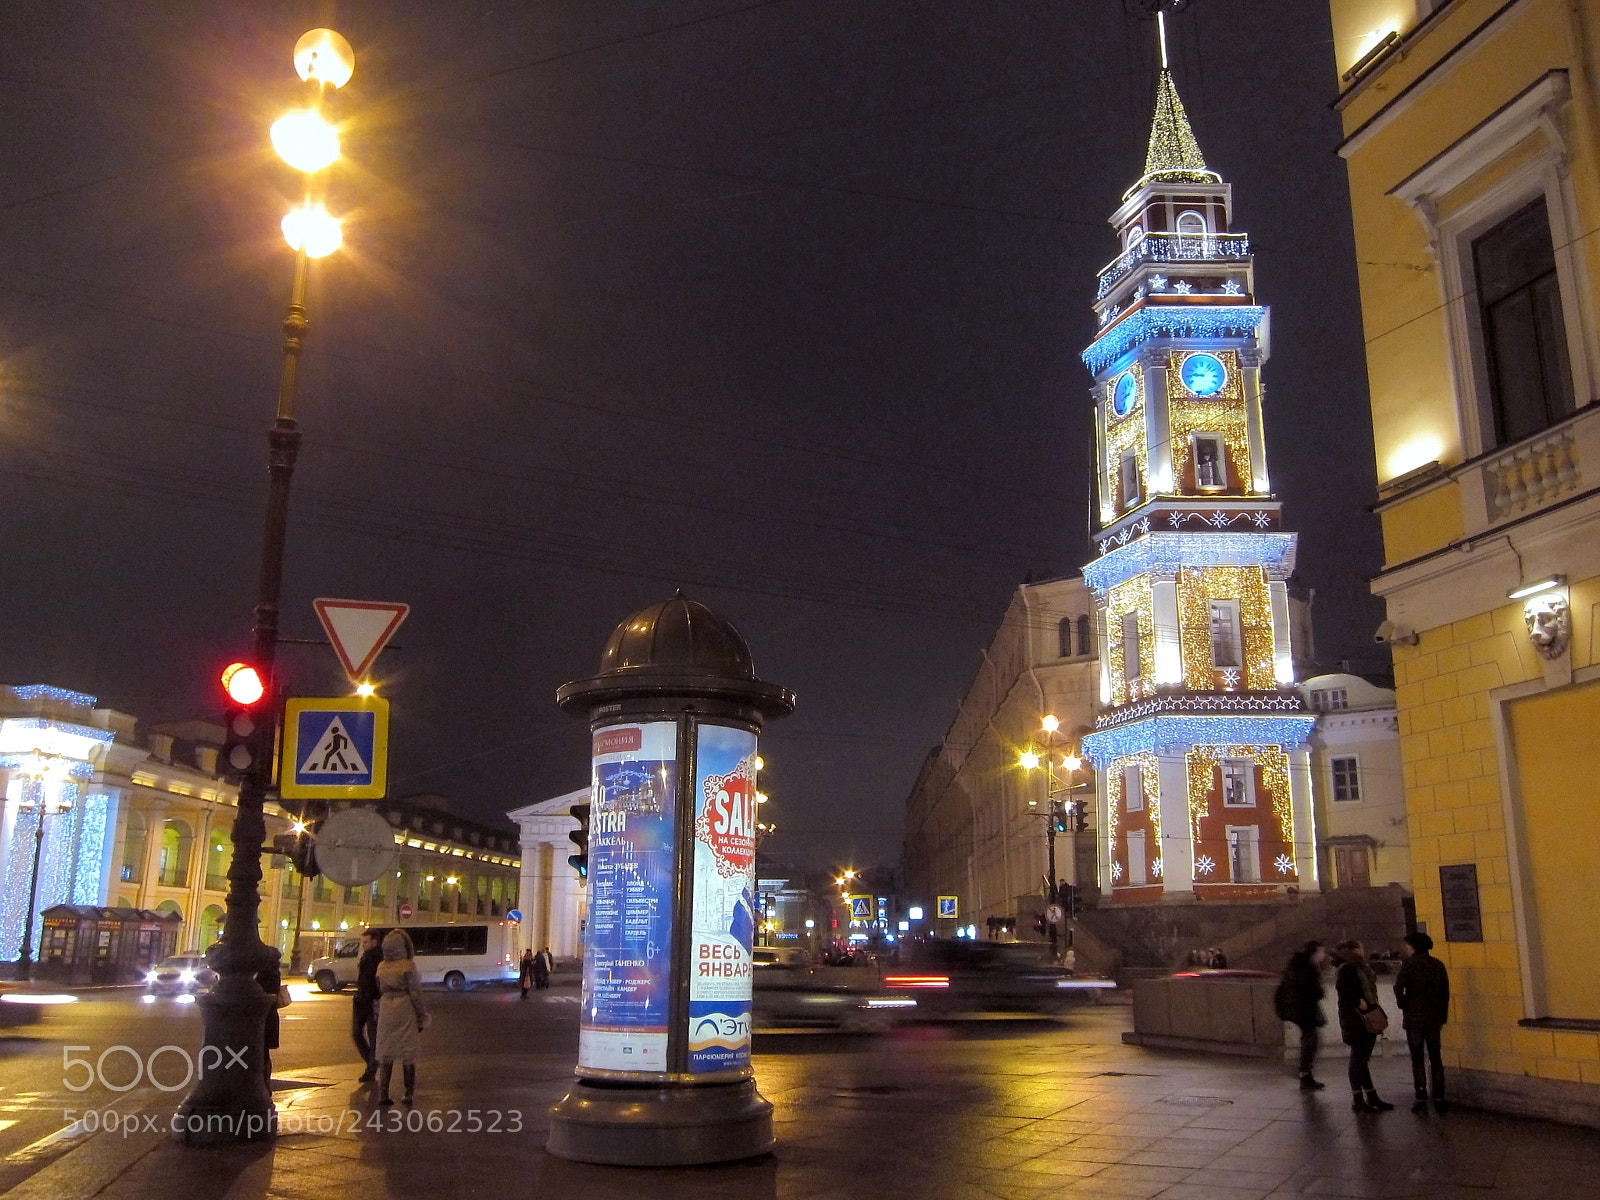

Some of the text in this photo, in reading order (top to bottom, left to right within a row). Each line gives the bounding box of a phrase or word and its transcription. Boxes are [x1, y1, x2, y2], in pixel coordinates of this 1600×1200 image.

[718, 837, 729, 845] НА
[646, 941, 661, 959] 6+
[699, 944, 741, 960] ВЕСЬ
